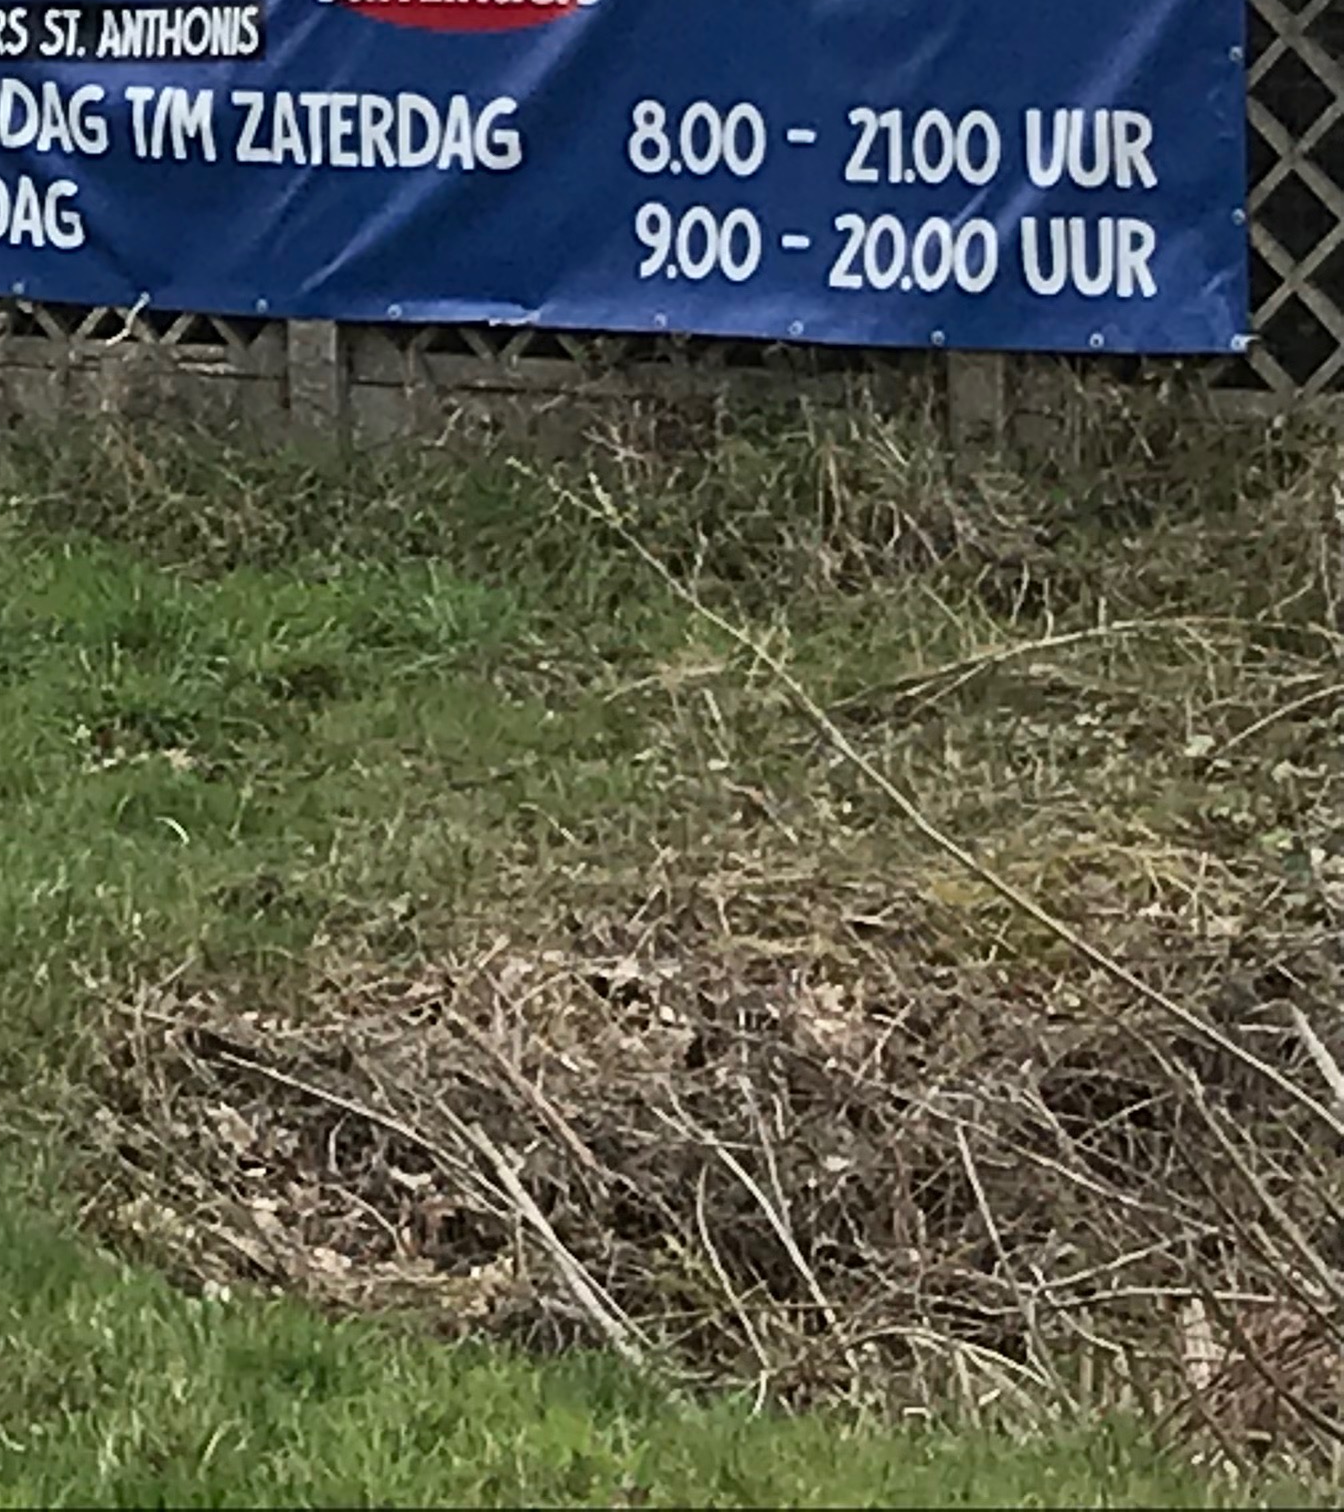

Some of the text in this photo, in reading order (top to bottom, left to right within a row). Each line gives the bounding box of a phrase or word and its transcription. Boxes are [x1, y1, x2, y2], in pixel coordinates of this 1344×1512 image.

[39, 8, 87, 57] ST.
[95, 5, 260, 59] ANTHONIS
[124, 86, 217, 162] T/M
[231, 91, 523, 171] ZATERDAG
[628, 100, 767, 177] 8.00
[843, 106, 1001, 185] 21.00
[1025, 108, 1158, 188] UUR
[634, 202, 762, 283] 9.00
[827, 213, 999, 294] 20.00
[1021, 216, 1157, 298] UUR
